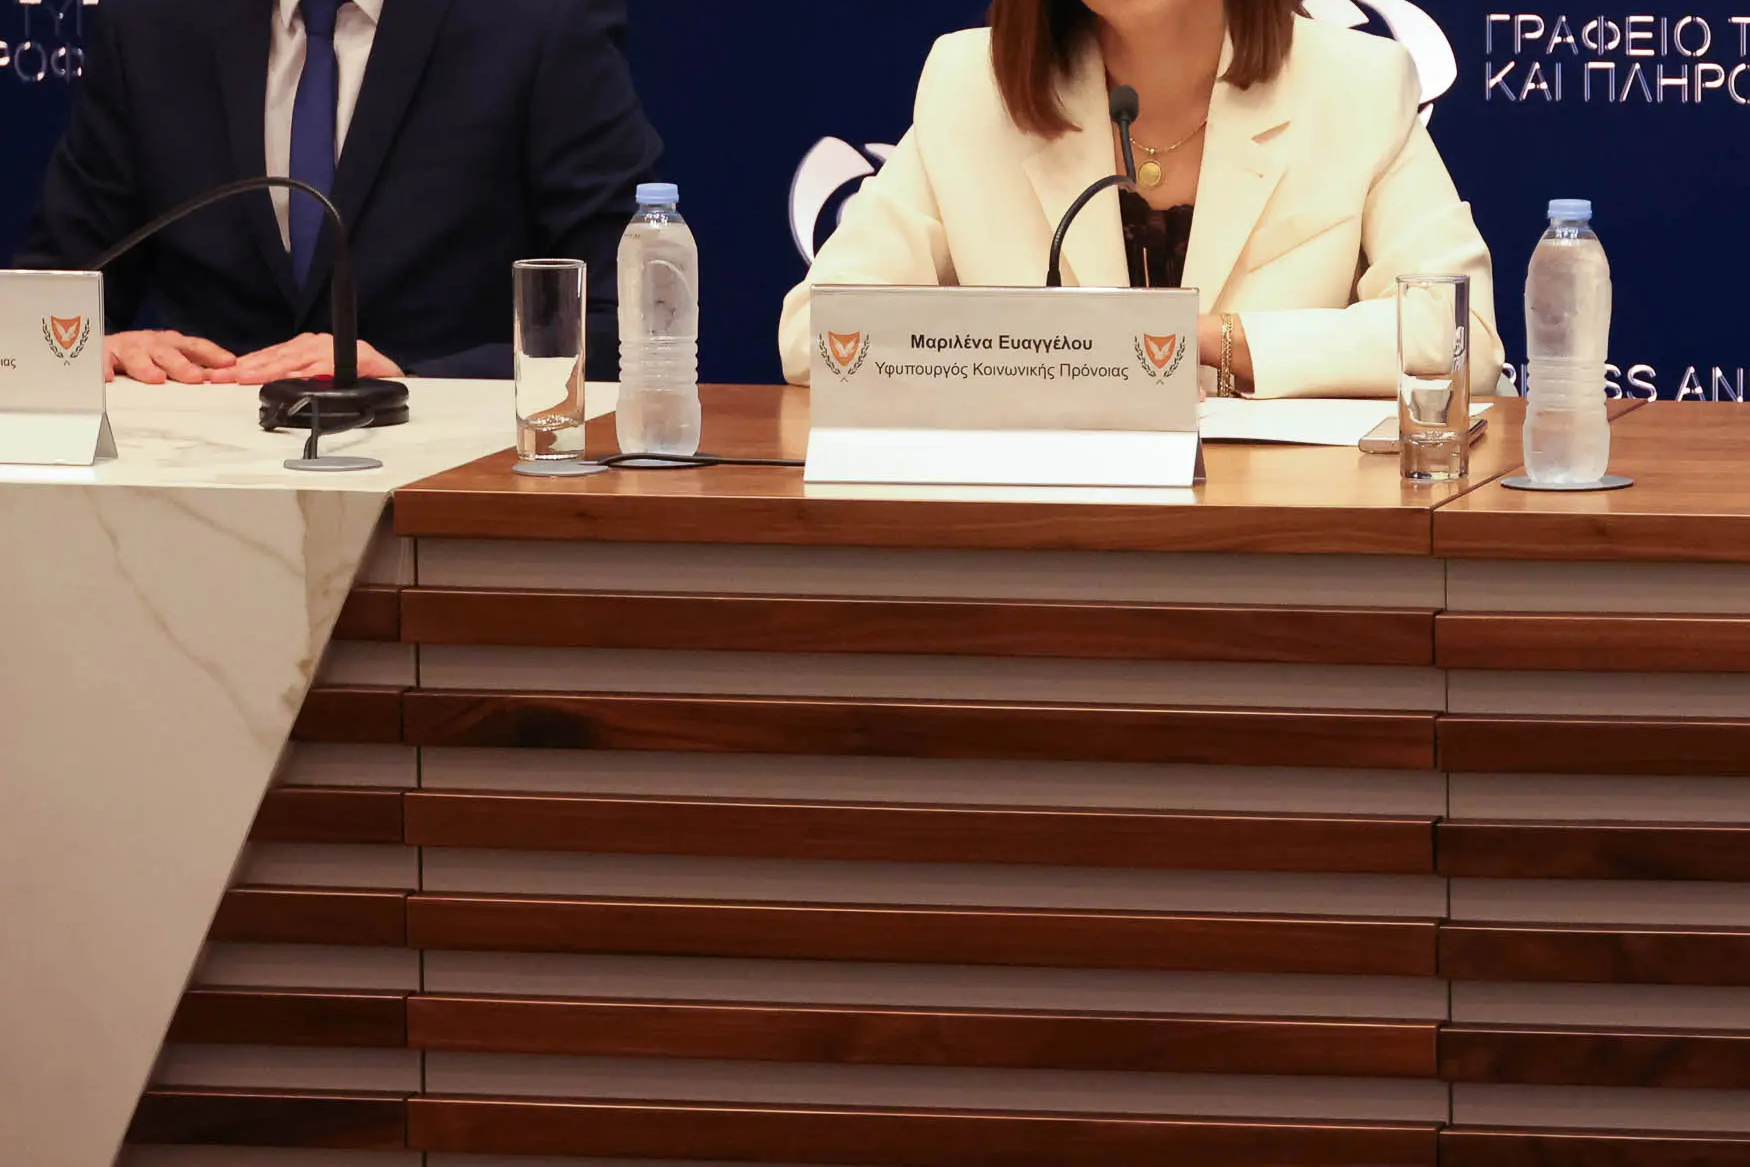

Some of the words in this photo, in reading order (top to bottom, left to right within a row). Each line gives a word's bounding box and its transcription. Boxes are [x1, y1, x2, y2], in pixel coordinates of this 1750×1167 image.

[1486, 13, 1712, 58] ΓΡΑΦΕΙΟ
[1485, 60, 1563, 102] ΚΑΙ
[911, 334, 993, 353] Μαριλένα
[998, 335, 1093, 354] Ευαγγέλου
[874, 361, 969, 379] Υφυπουργός
[973, 362, 1056, 380] Κοινωνικής
[1060, 363, 1129, 381] Πρόνοιας
